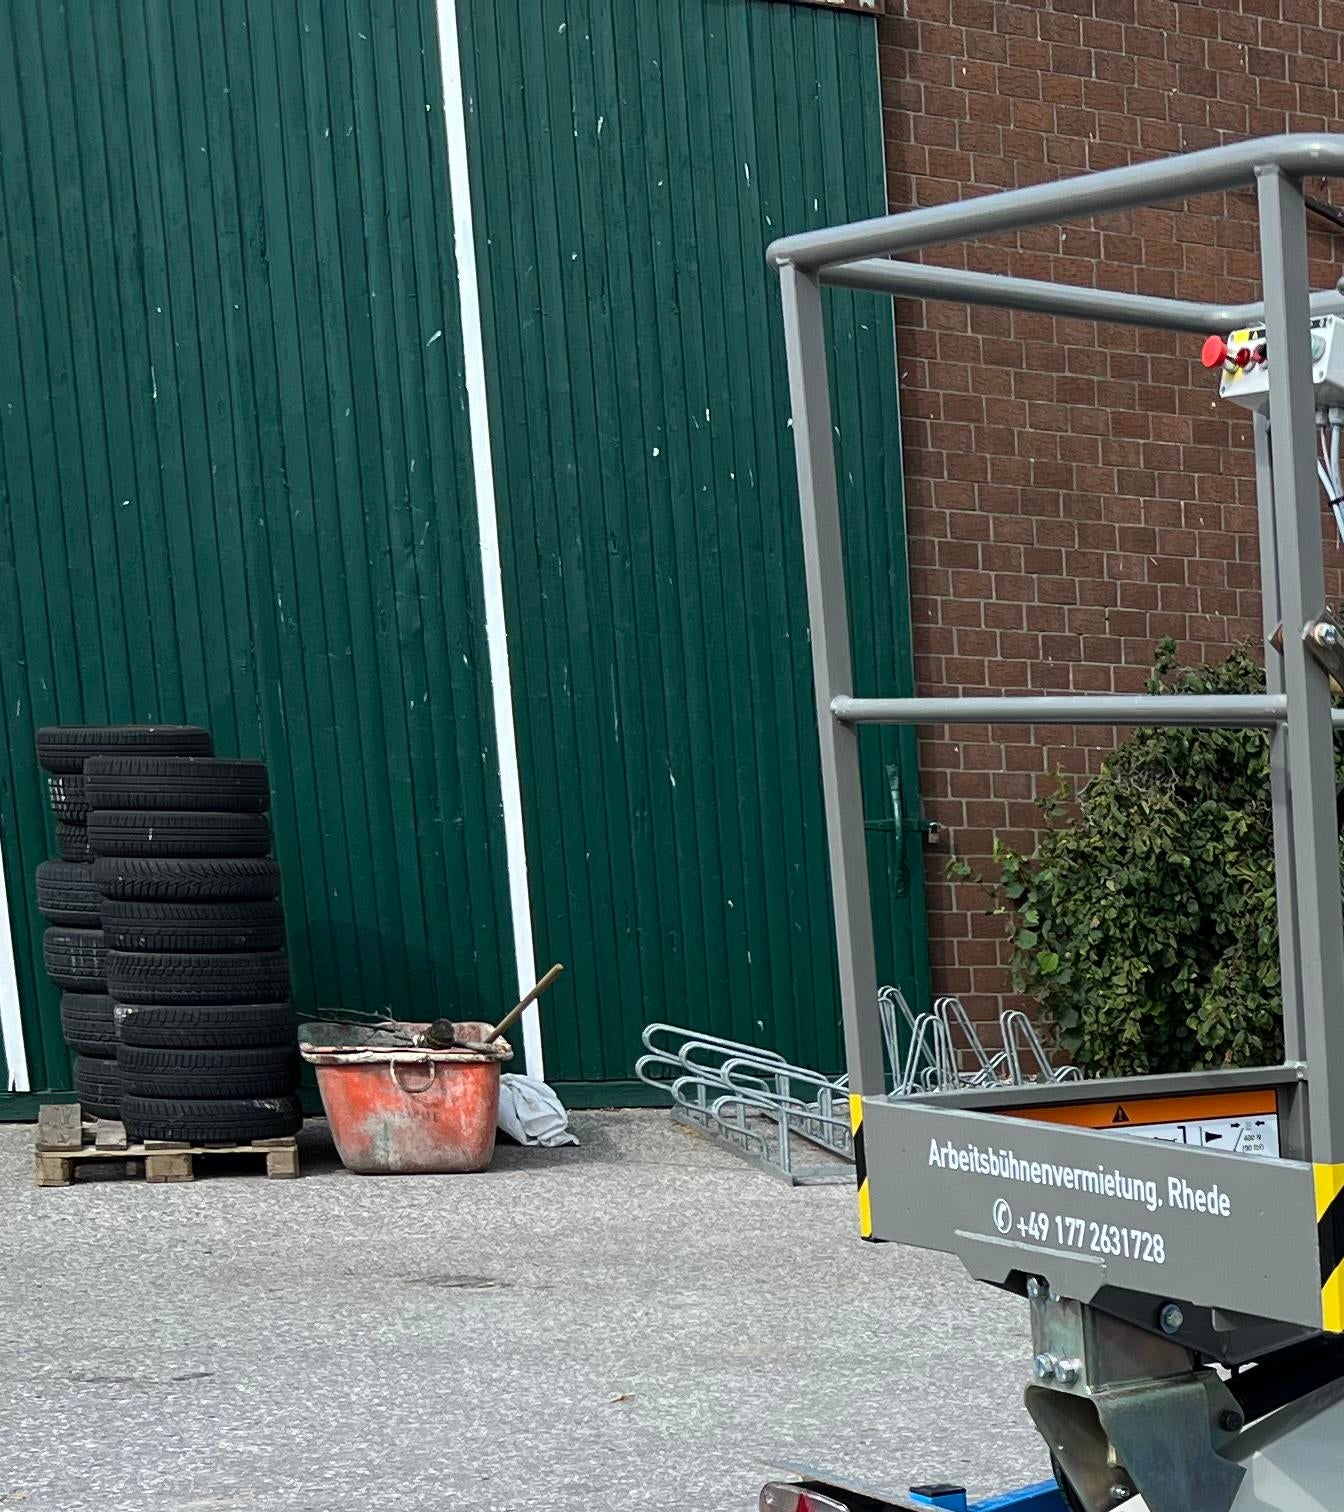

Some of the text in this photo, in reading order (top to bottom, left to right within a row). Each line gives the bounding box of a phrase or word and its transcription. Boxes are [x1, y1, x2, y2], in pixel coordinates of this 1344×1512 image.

[1168, 1177, 1231, 1217] Rhede
[1017, 1211, 1166, 1265] +49 177 2631728
